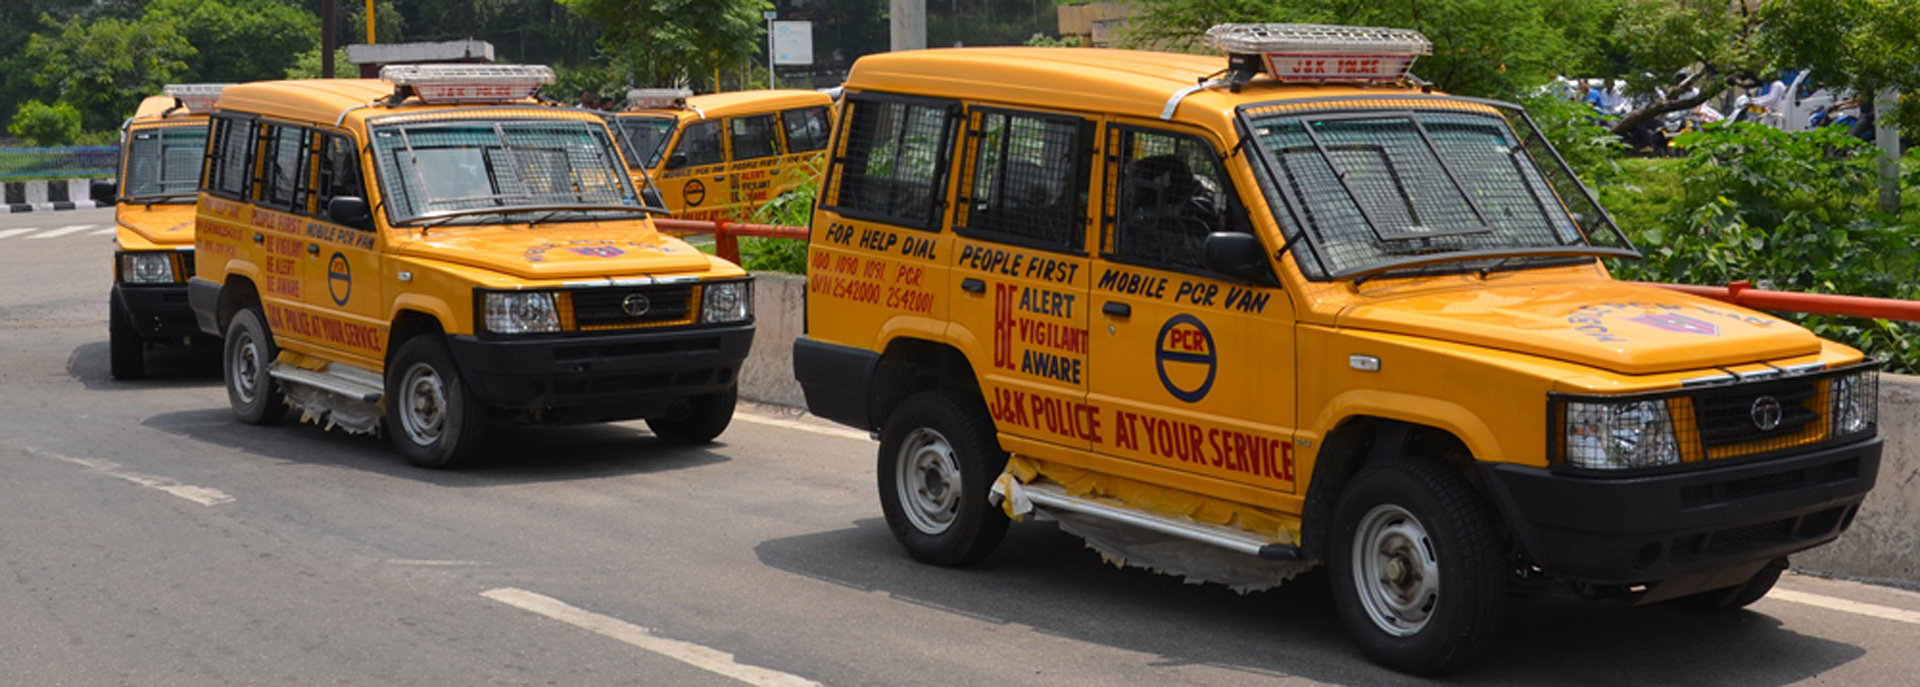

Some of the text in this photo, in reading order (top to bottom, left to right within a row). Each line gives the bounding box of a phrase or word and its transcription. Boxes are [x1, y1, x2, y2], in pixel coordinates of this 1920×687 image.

[1337, 59, 1380, 74] POLICE
[251, 207, 276, 231] PEOPLE
[278, 213, 303, 235] FIRST
[306, 220, 336, 243] MOBILE
[337, 228, 355, 247] PCR
[266, 235, 277, 254] BE
[826, 222, 937, 260] FOR HELP DIAL
[266, 254, 295, 277] BE ALERT
[958, 245, 1079, 285] PEOPLE FIRST
[1019, 286, 1075, 319] ALERT
[1098, 268, 1270, 314] MOBILE PCR VAN
[284, 307, 312, 337] POLICE
[344, 322, 381, 352] SERVICE
[994, 282, 1018, 371] BE
[1019, 317, 1088, 355] VIGILANT
[1171, 328, 1205, 352] PCR
[1021, 349, 1081, 385] AWARE
[990, 386, 1295, 482] J&K POLICE AT YOUR SERVICE
